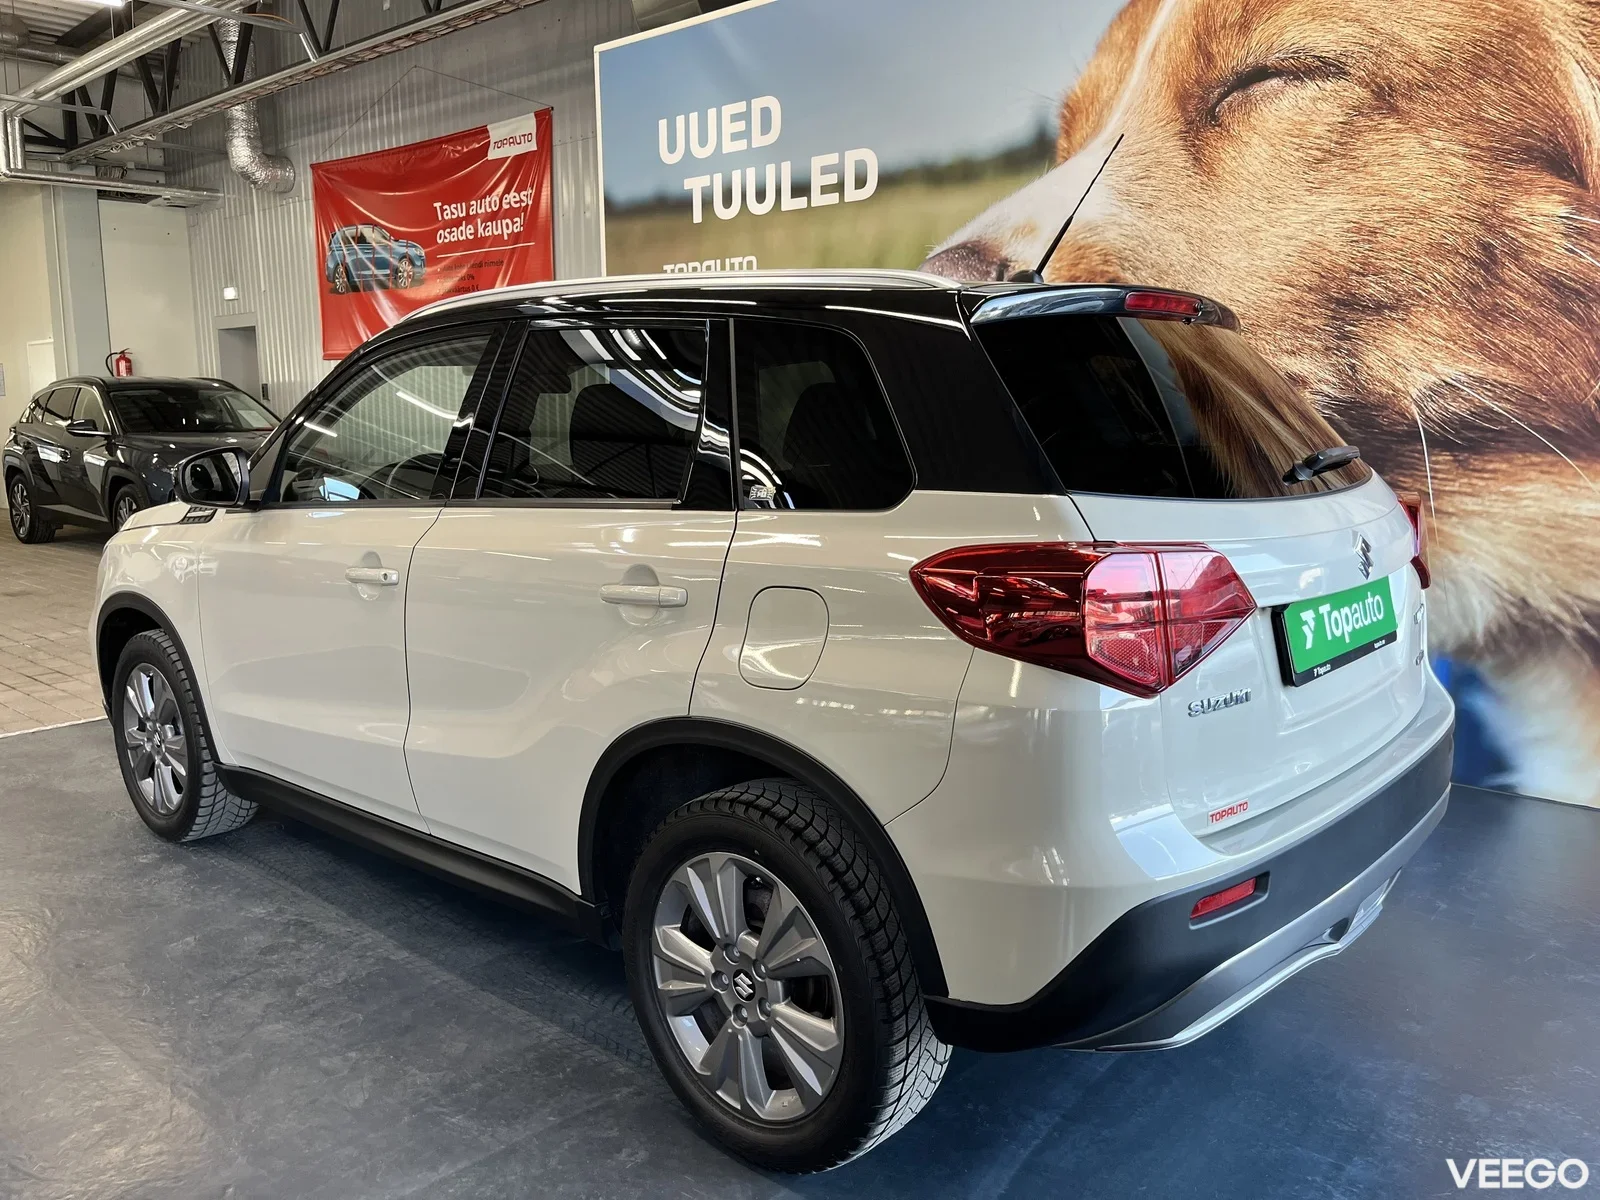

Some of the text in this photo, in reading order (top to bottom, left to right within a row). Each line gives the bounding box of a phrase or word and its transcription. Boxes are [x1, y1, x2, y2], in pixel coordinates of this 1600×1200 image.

[493, 132, 533, 150] TOPAUTO
[658, 95, 782, 165] UUED
[683, 147, 879, 223] TUULED
[433, 188, 533, 221] Tasu auto eest
[437, 212, 524, 244] osade kaupa!
[1318, 591, 1384, 643] Topauto
[1187, 687, 1252, 718] SUZUKI
[1209, 800, 1249, 824] TOPAUTO
